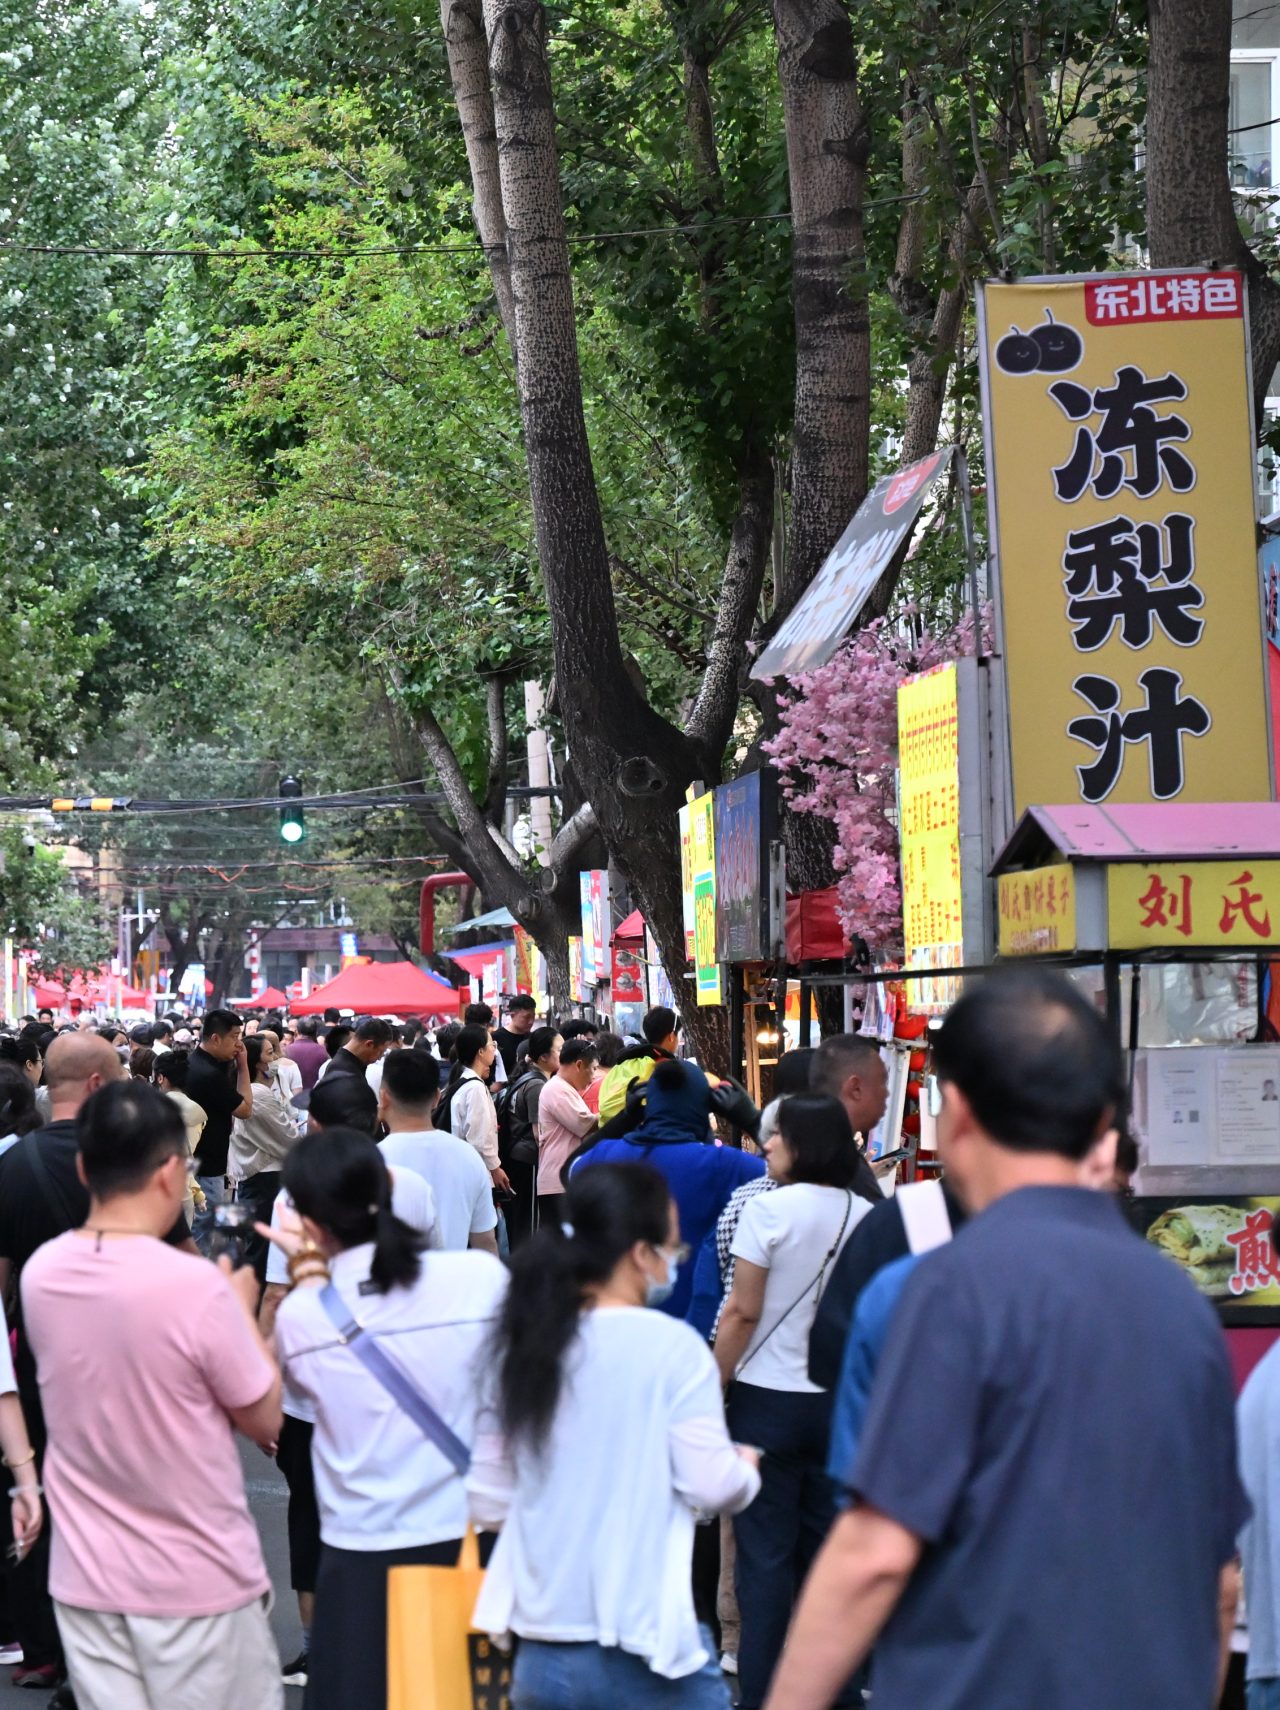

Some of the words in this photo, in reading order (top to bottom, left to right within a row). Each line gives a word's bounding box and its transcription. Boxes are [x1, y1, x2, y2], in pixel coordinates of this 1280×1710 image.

[1094, 277, 1237, 319] 东北特色
[1049, 365, 1211, 803] 冻梨汁
[1139, 871, 1272, 938] 刘氏
